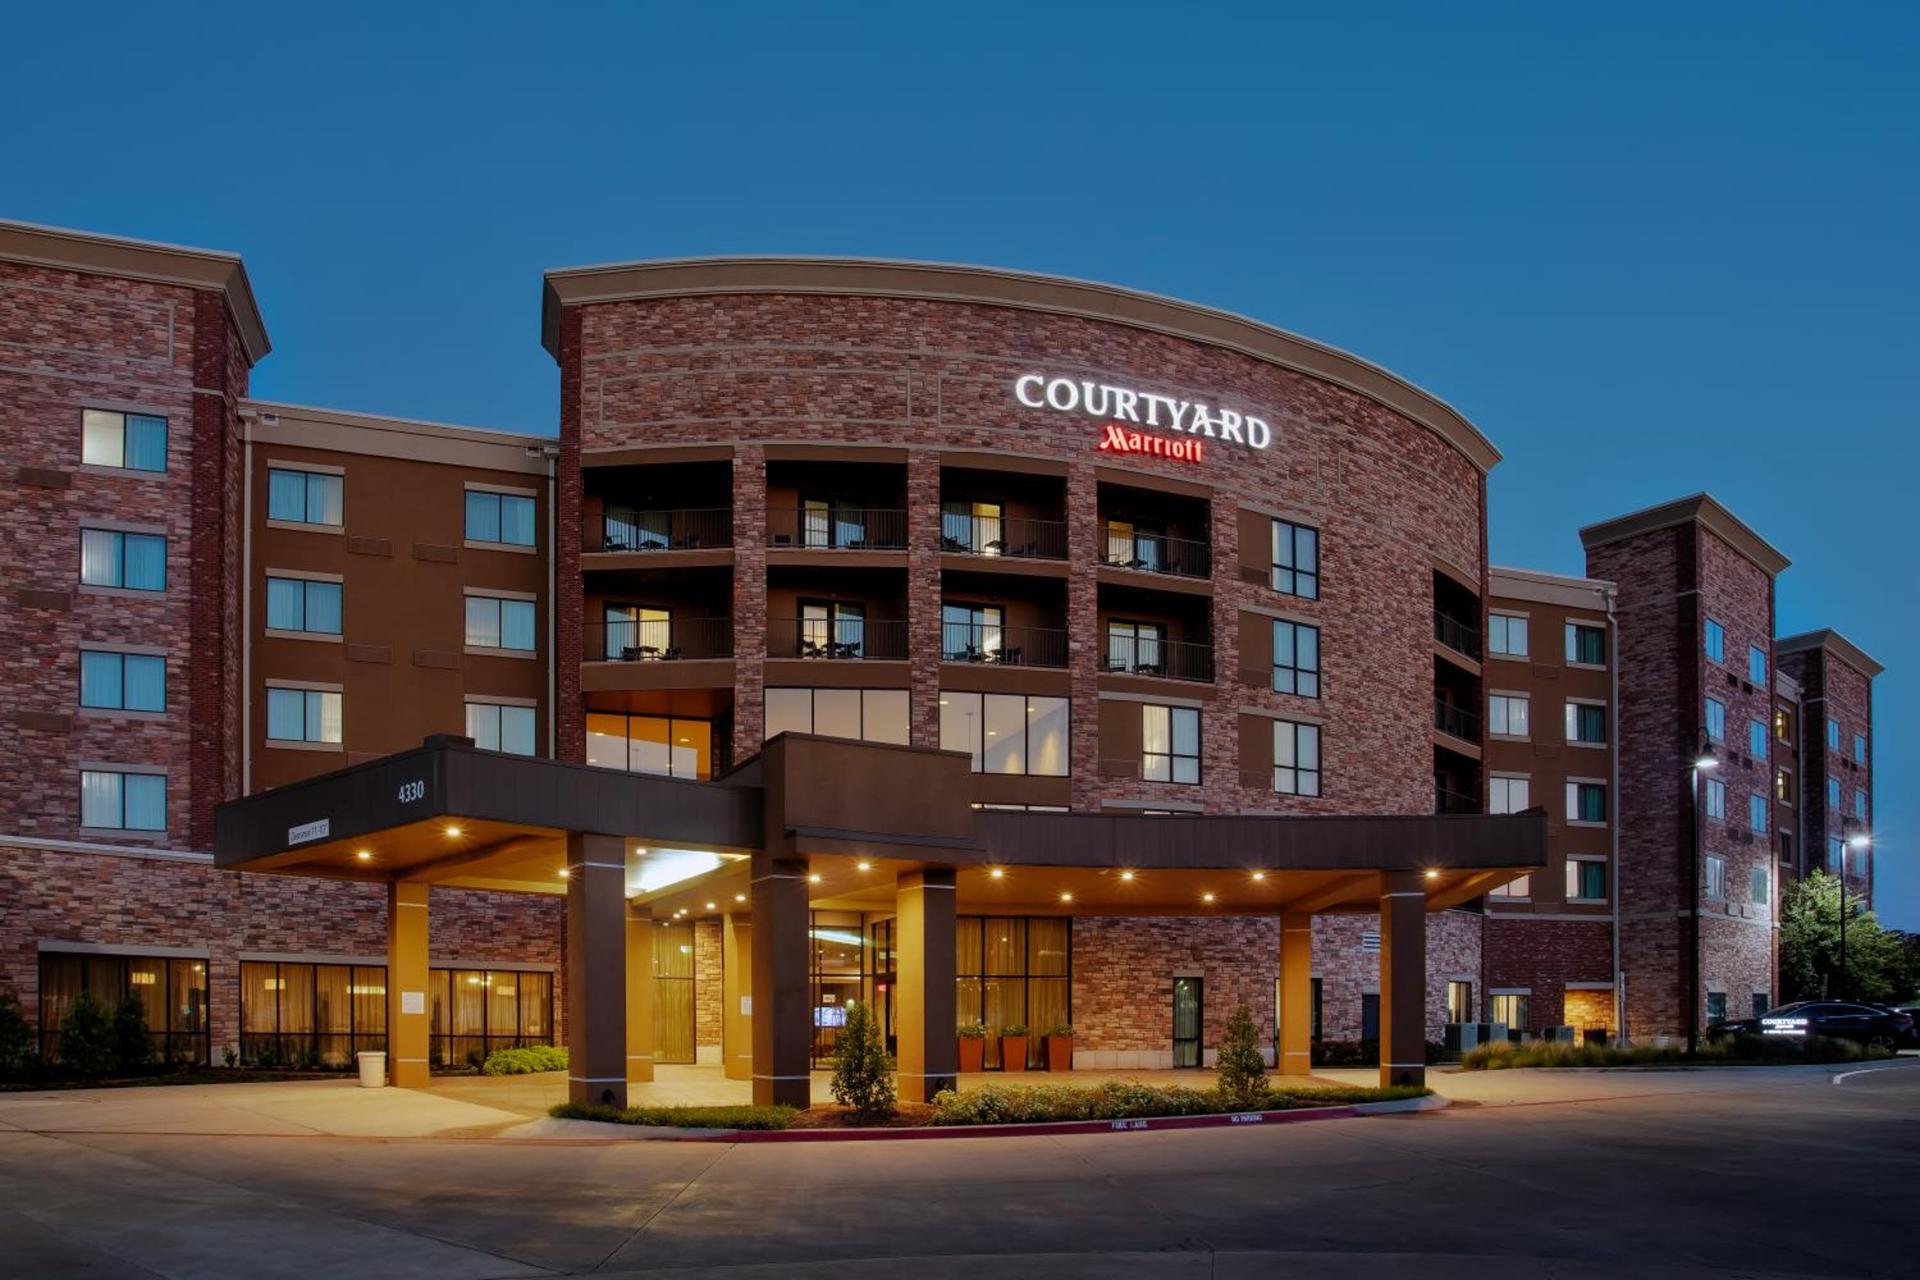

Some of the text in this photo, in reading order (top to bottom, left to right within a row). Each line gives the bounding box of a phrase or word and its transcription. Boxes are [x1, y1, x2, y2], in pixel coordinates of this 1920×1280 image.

[1015, 375, 1271, 449] COURTYARD
[1099, 425, 1202, 462] Marriott
[399, 780, 424, 803] 4330
